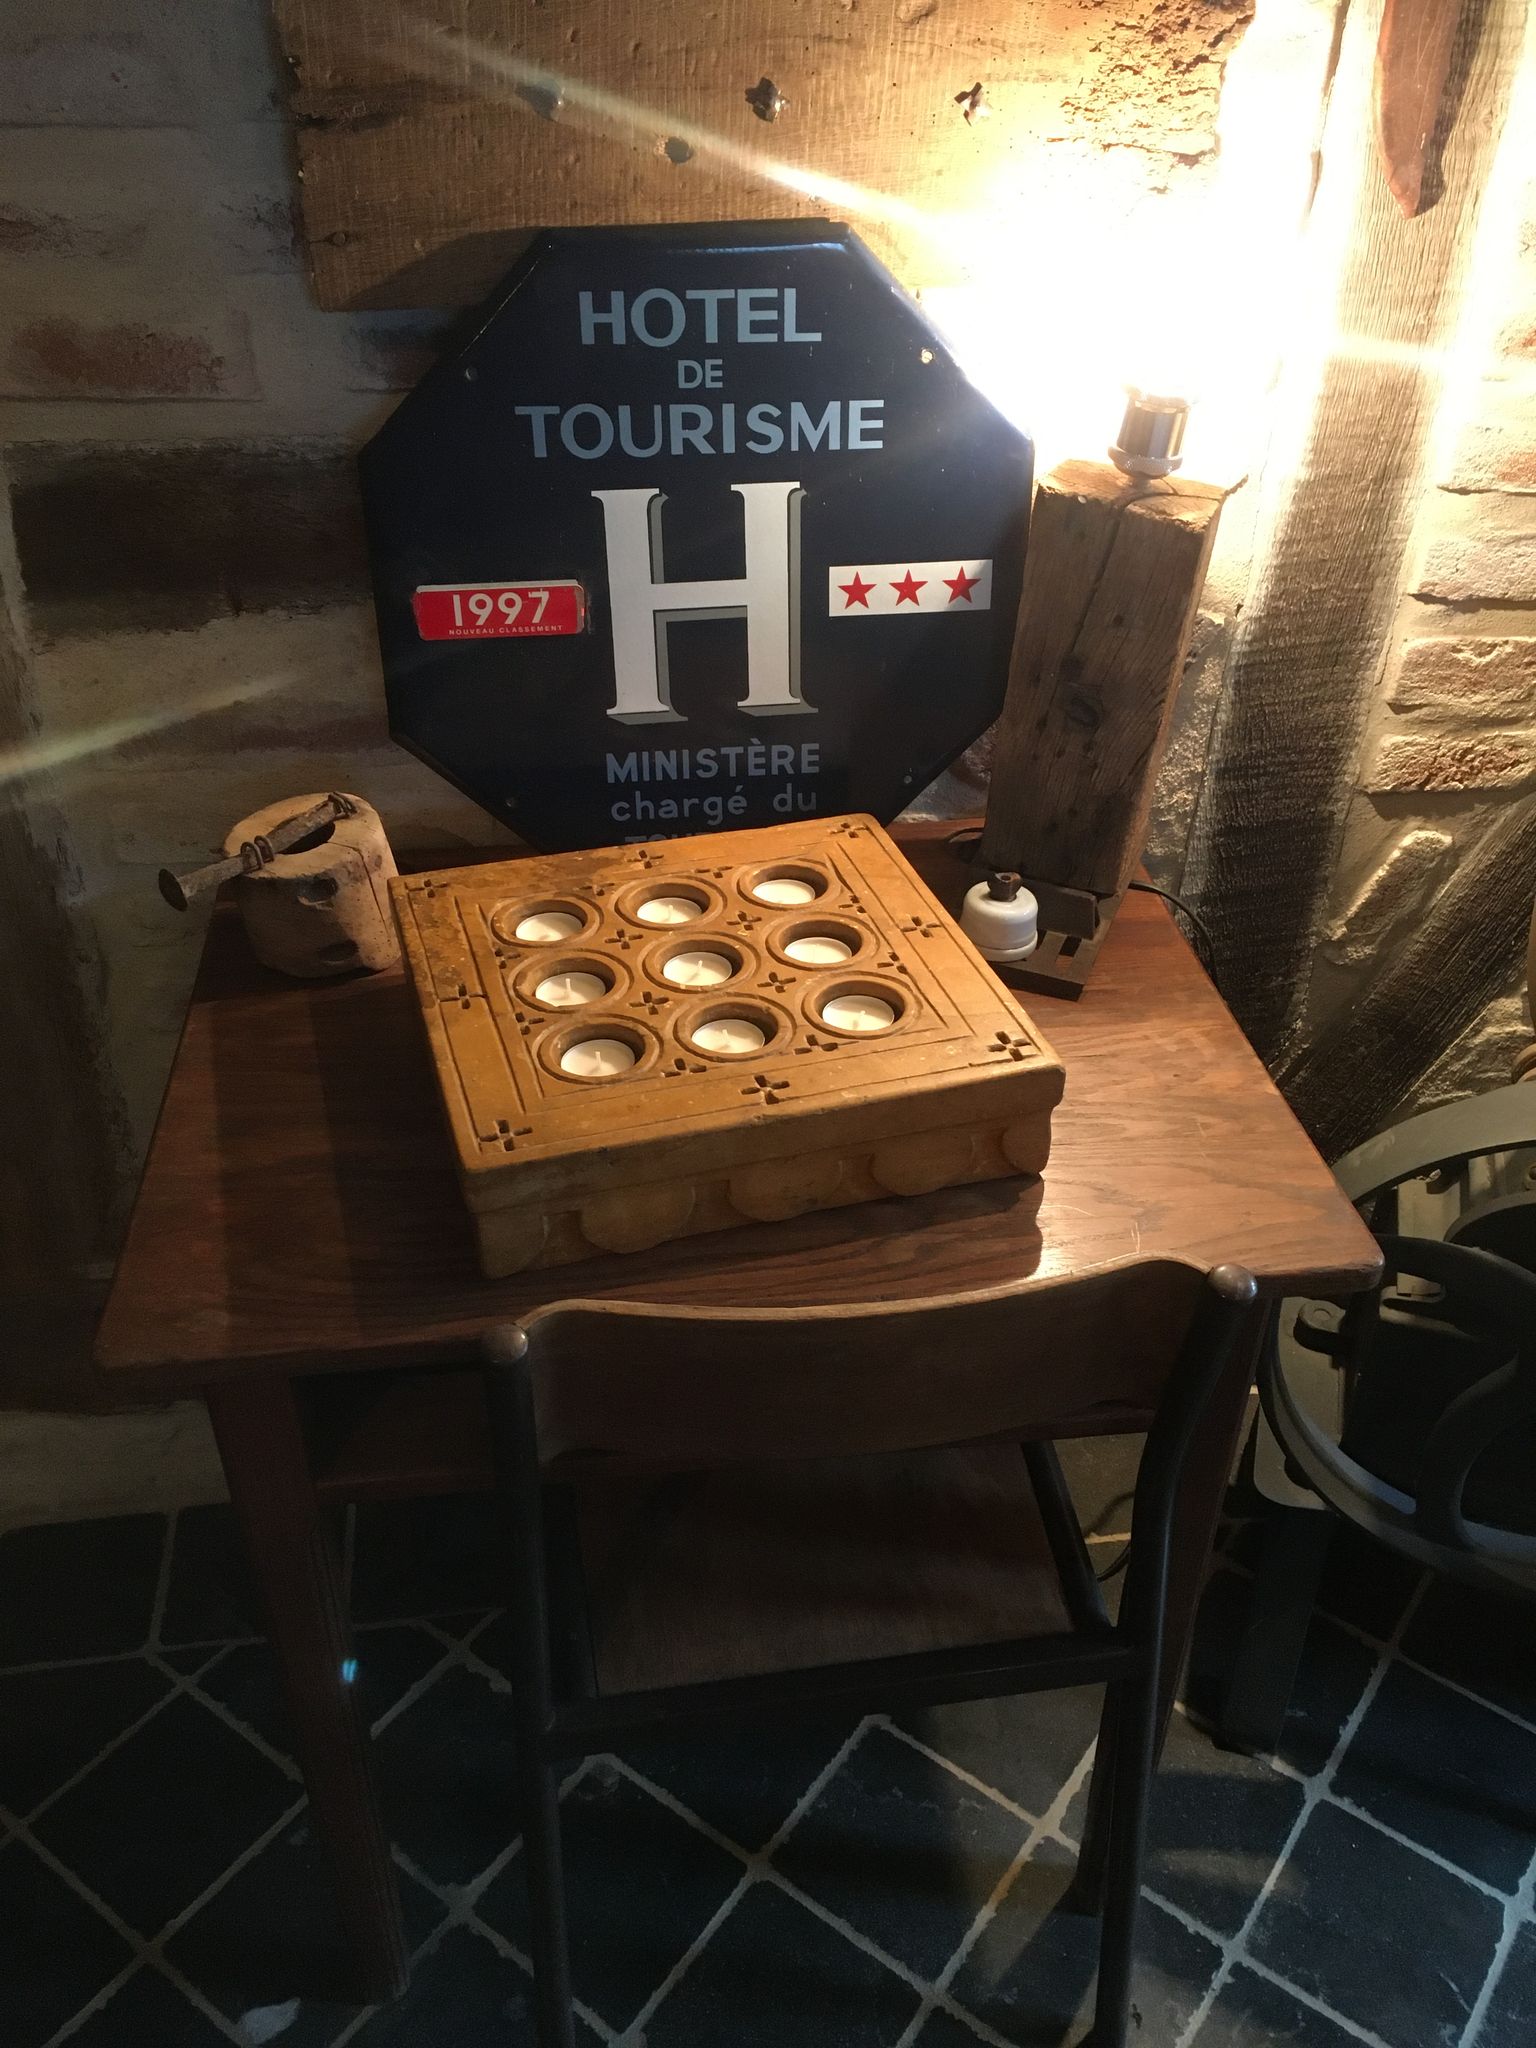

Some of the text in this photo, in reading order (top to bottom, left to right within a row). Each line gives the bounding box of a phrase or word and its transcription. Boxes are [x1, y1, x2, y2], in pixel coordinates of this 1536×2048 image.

[578, 287, 822, 347] HOTEL
[677, 359, 723, 389] DE
[514, 399, 885, 460] TOURISME
[452, 588, 550, 627] 1997
[591, 481, 819, 725] H
[449, 625, 563, 636] NOUVEAU CLASSEMENT
[606, 738, 820, 784] MINISTÈRE
[610, 783, 817, 826] chargé du
